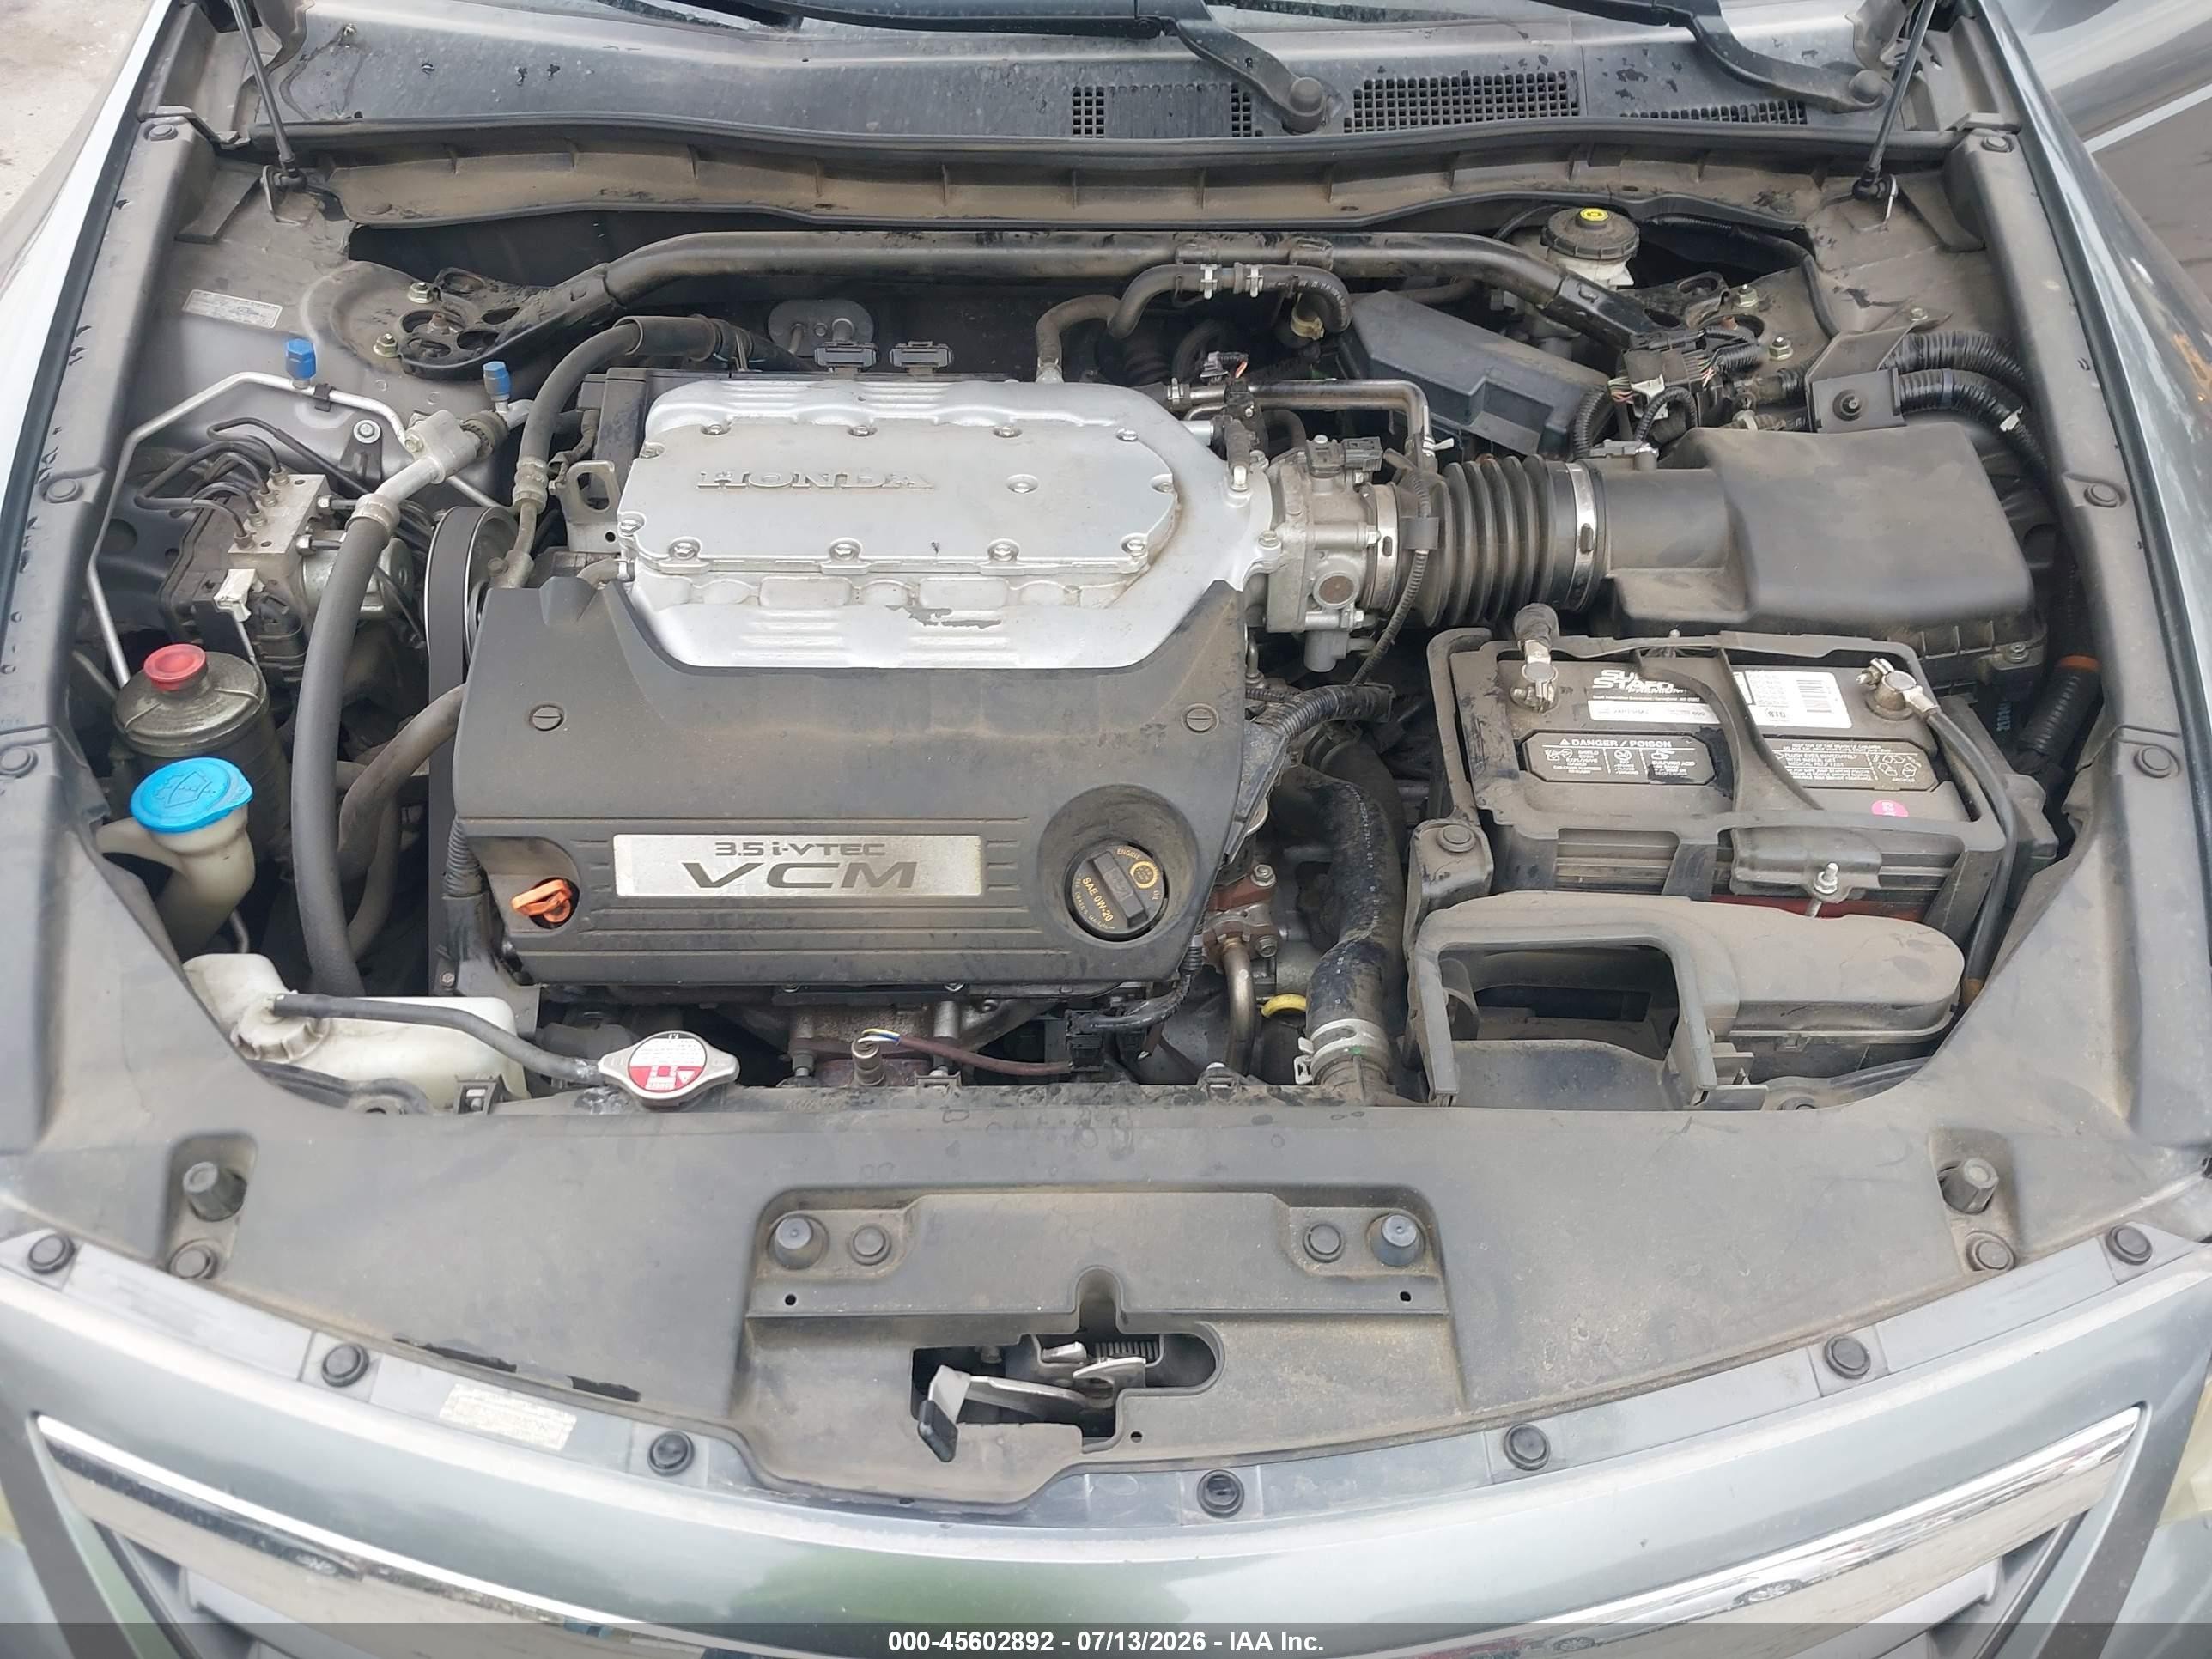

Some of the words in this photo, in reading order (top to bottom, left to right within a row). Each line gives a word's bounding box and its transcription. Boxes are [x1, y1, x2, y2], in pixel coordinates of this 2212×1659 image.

[696, 471, 935, 490] HONDA
[1571, 738, 1618, 747] DANGER
[714, 842, 764, 856] 3.5
[772, 841, 886, 856] i-VTEC
[1116, 848, 1140, 860] ENGINE
[682, 862, 918, 889] VCM
[1083, 877, 1098, 896] SAE
[1094, 896, 1114, 921] 0W-20
